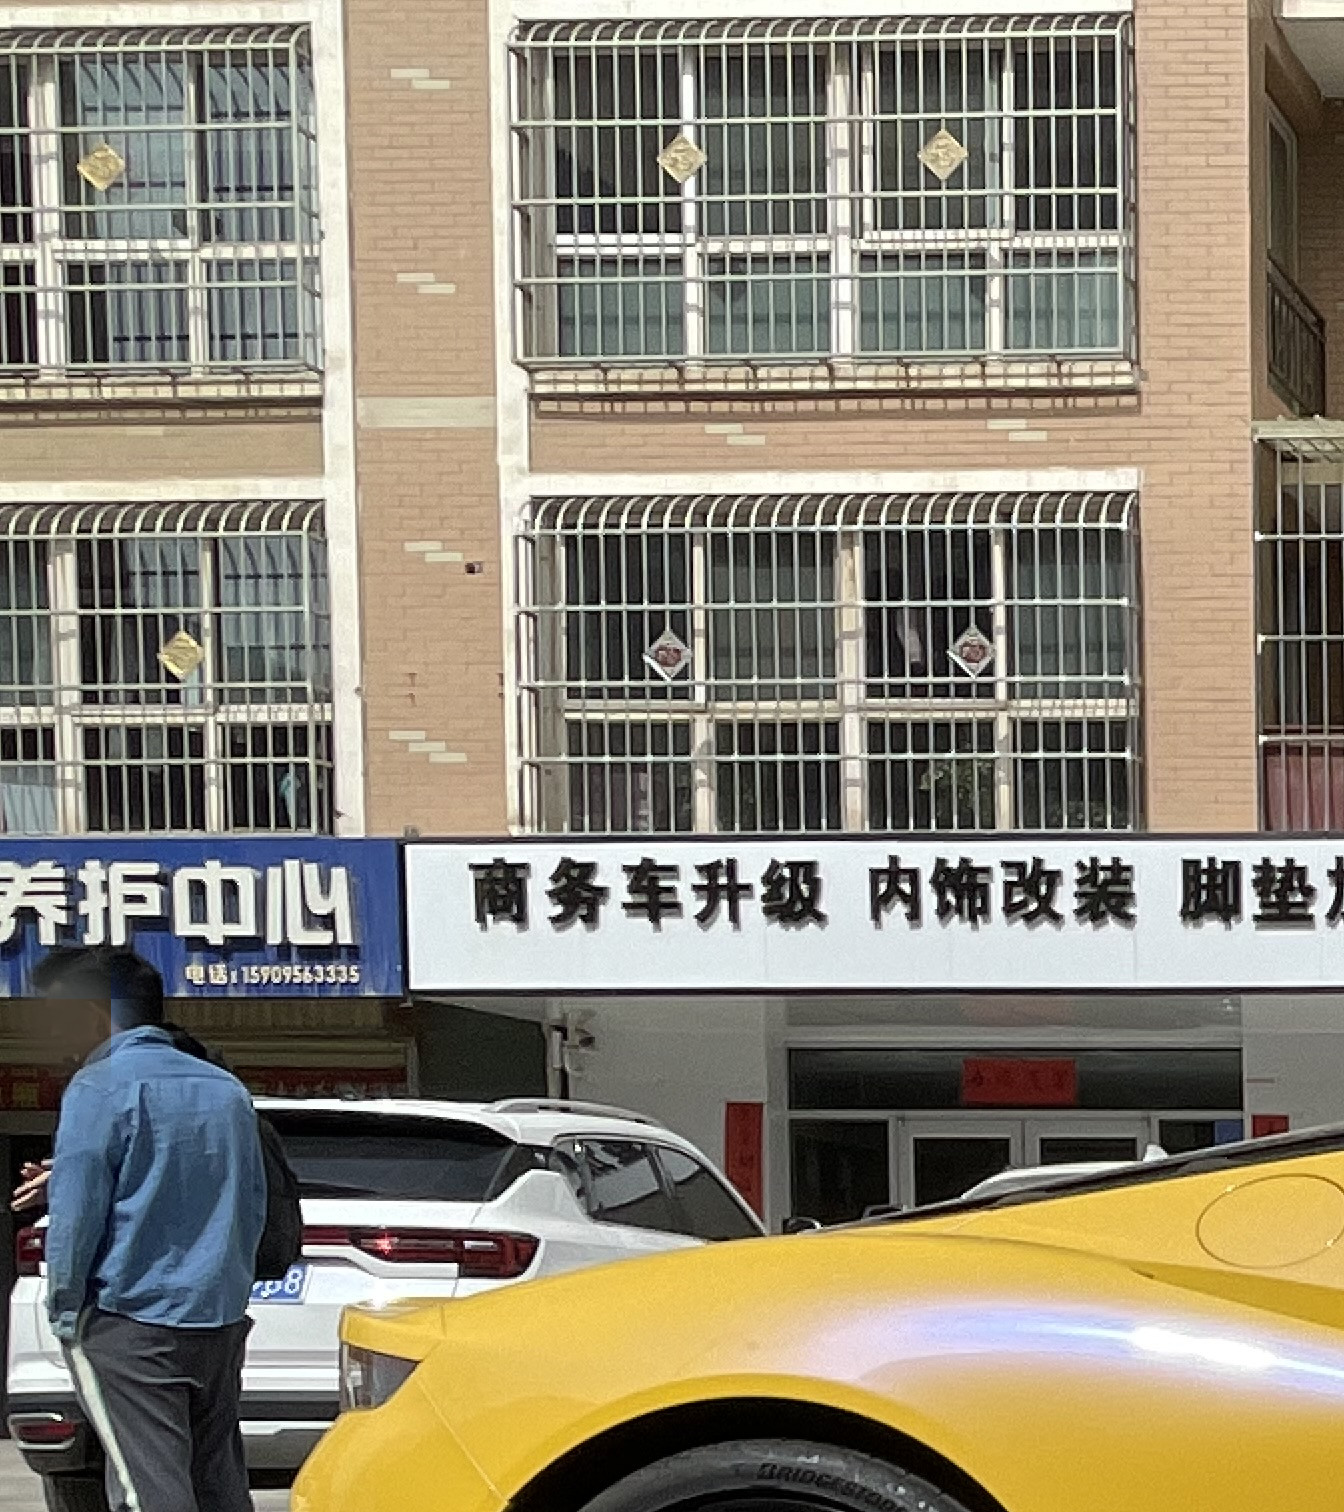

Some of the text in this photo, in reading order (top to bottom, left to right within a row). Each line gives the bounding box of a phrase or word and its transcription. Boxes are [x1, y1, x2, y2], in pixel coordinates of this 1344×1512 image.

[0, 860, 353, 946] 养护中心
[468, 856, 826, 927] 商务车升级
[868, 855, 1136, 927] 内饰改装
